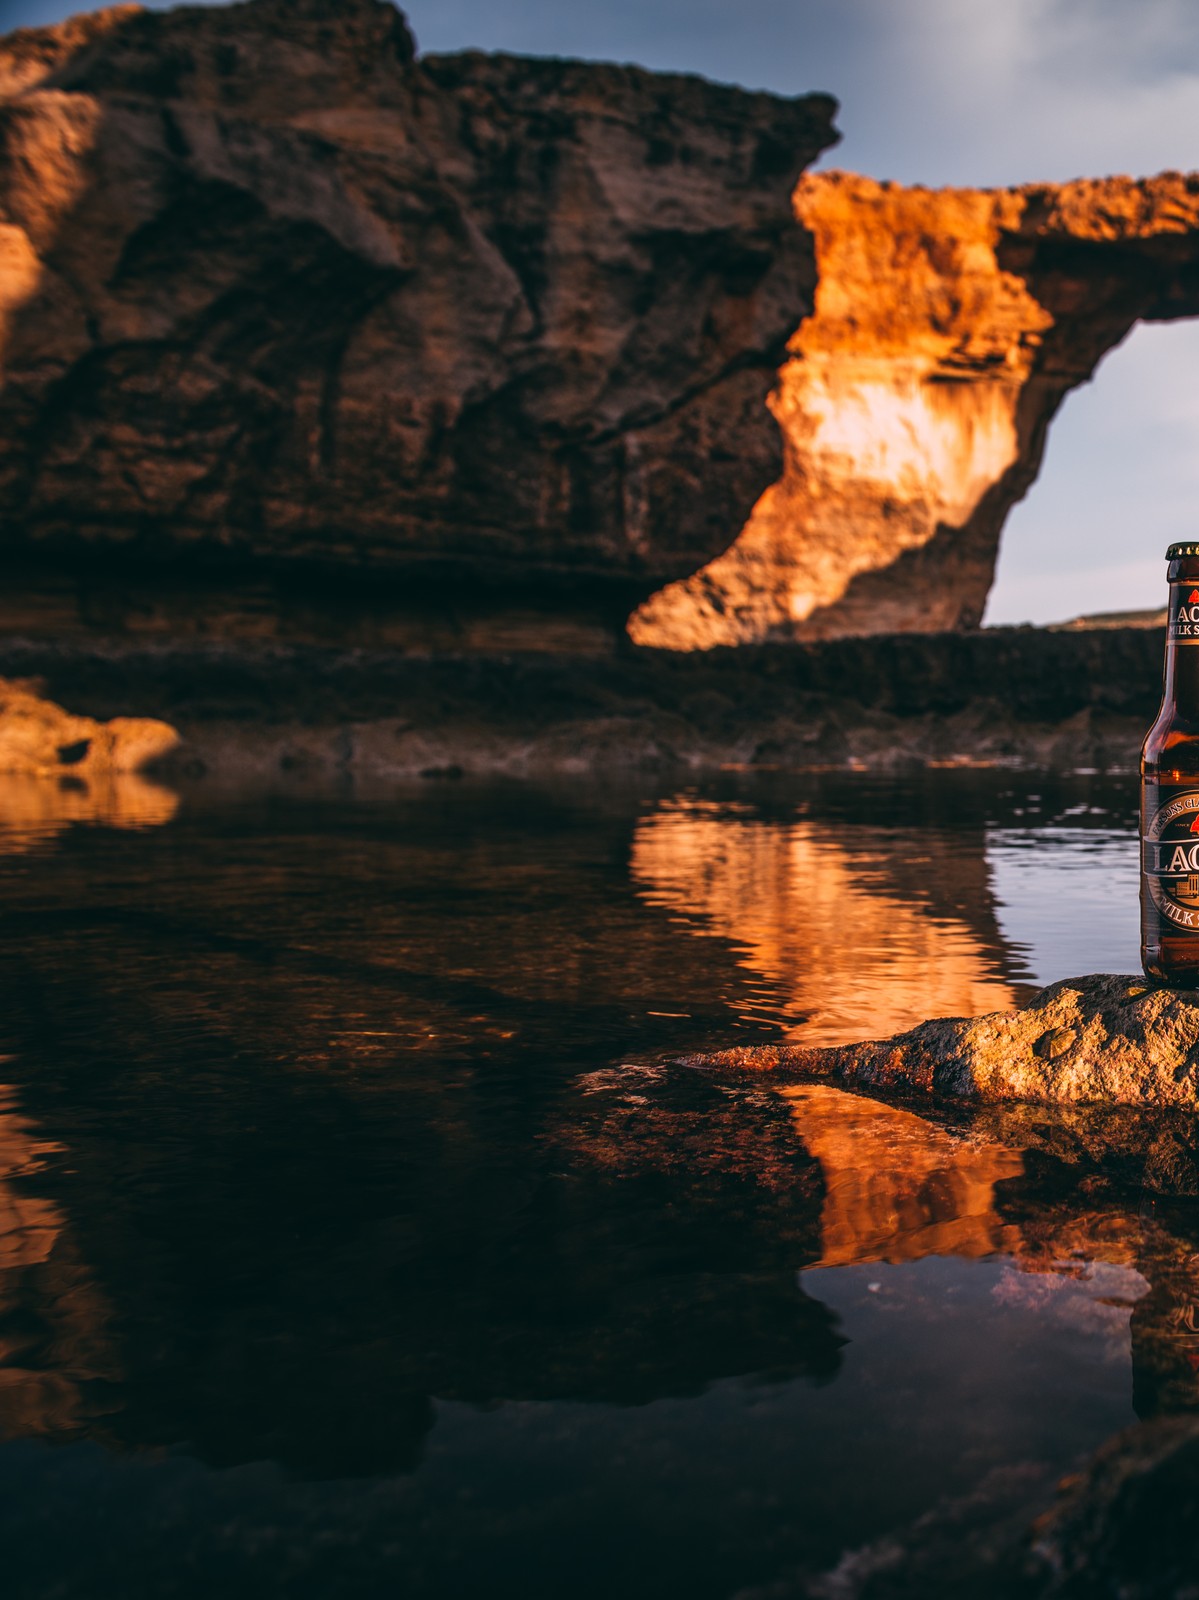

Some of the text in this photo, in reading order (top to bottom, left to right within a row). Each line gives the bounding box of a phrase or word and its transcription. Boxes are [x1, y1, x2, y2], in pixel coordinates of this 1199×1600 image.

[1169, 624, 1192, 635] MILK
[1152, 801, 1184, 836] FARSONS
[1160, 896, 1194, 926] MILK
